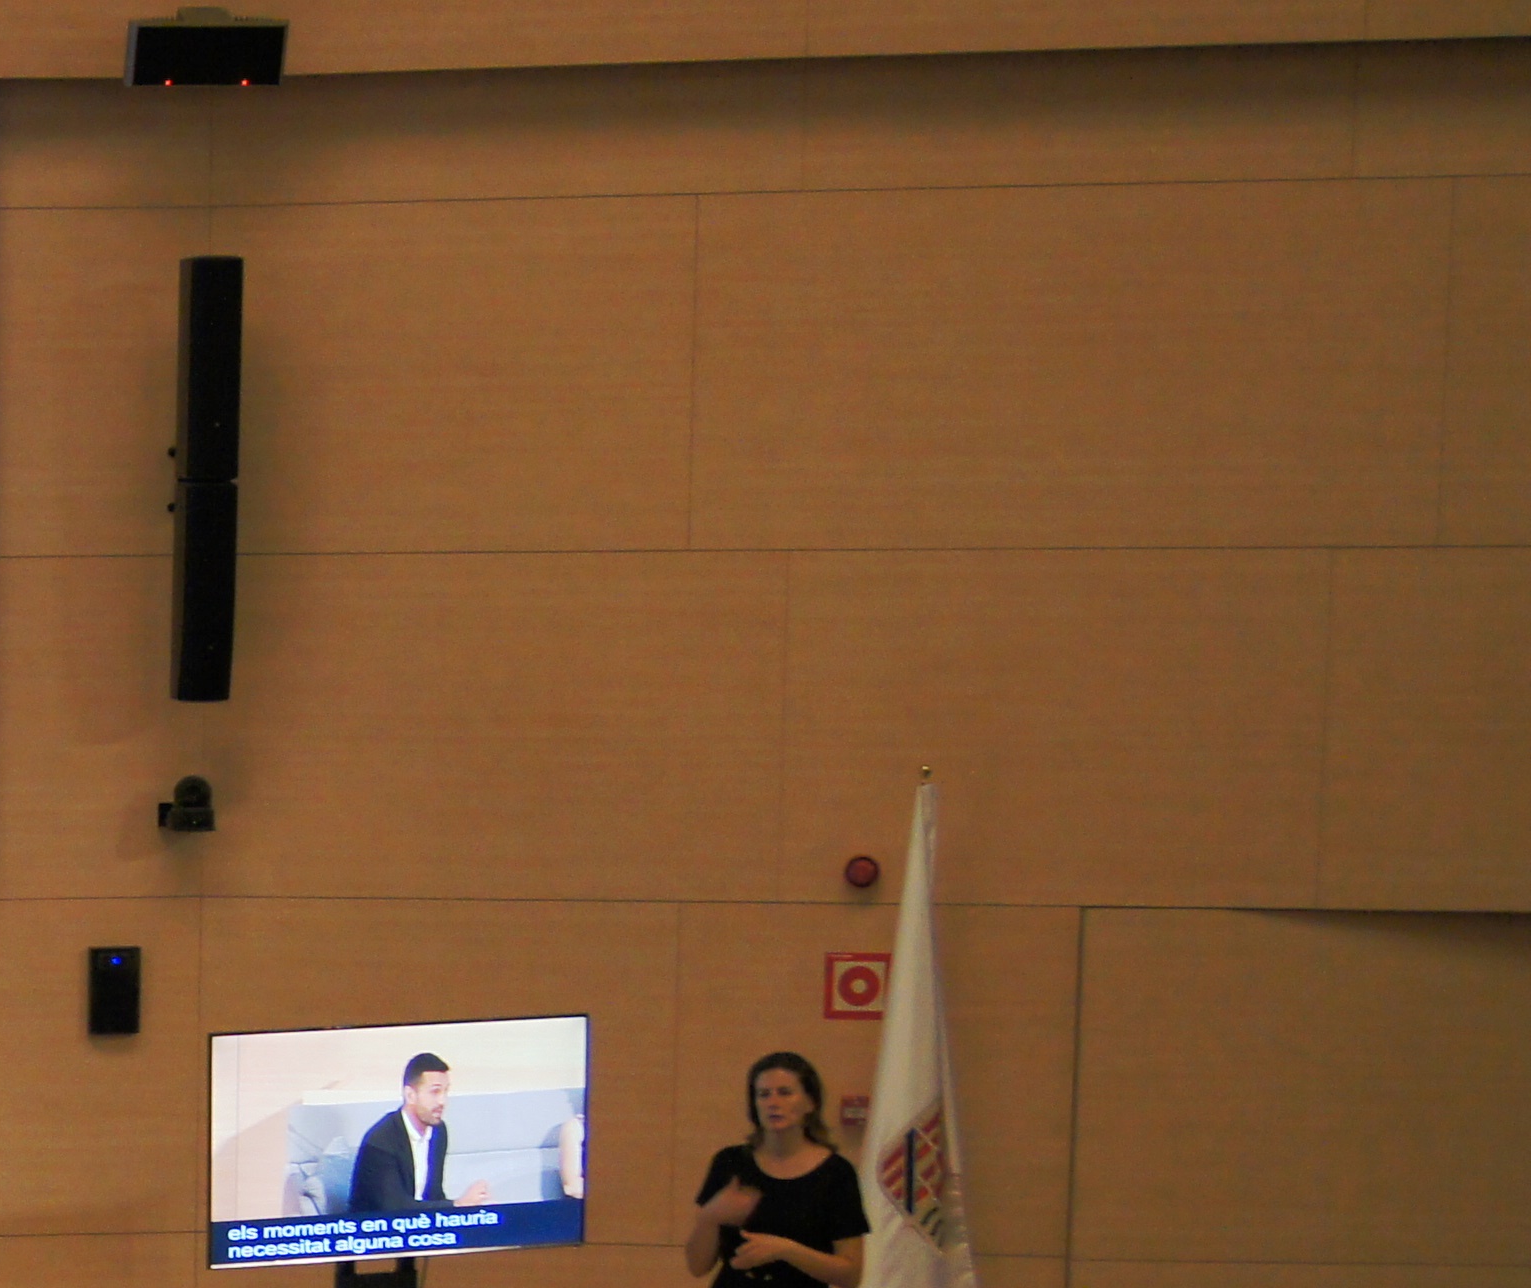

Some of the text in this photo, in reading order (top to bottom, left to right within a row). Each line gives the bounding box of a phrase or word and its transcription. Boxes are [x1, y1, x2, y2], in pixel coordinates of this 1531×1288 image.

[228, 1210, 499, 1241] els moments en què hauria
[228, 1232, 457, 1259] necessitat alguna cosa
